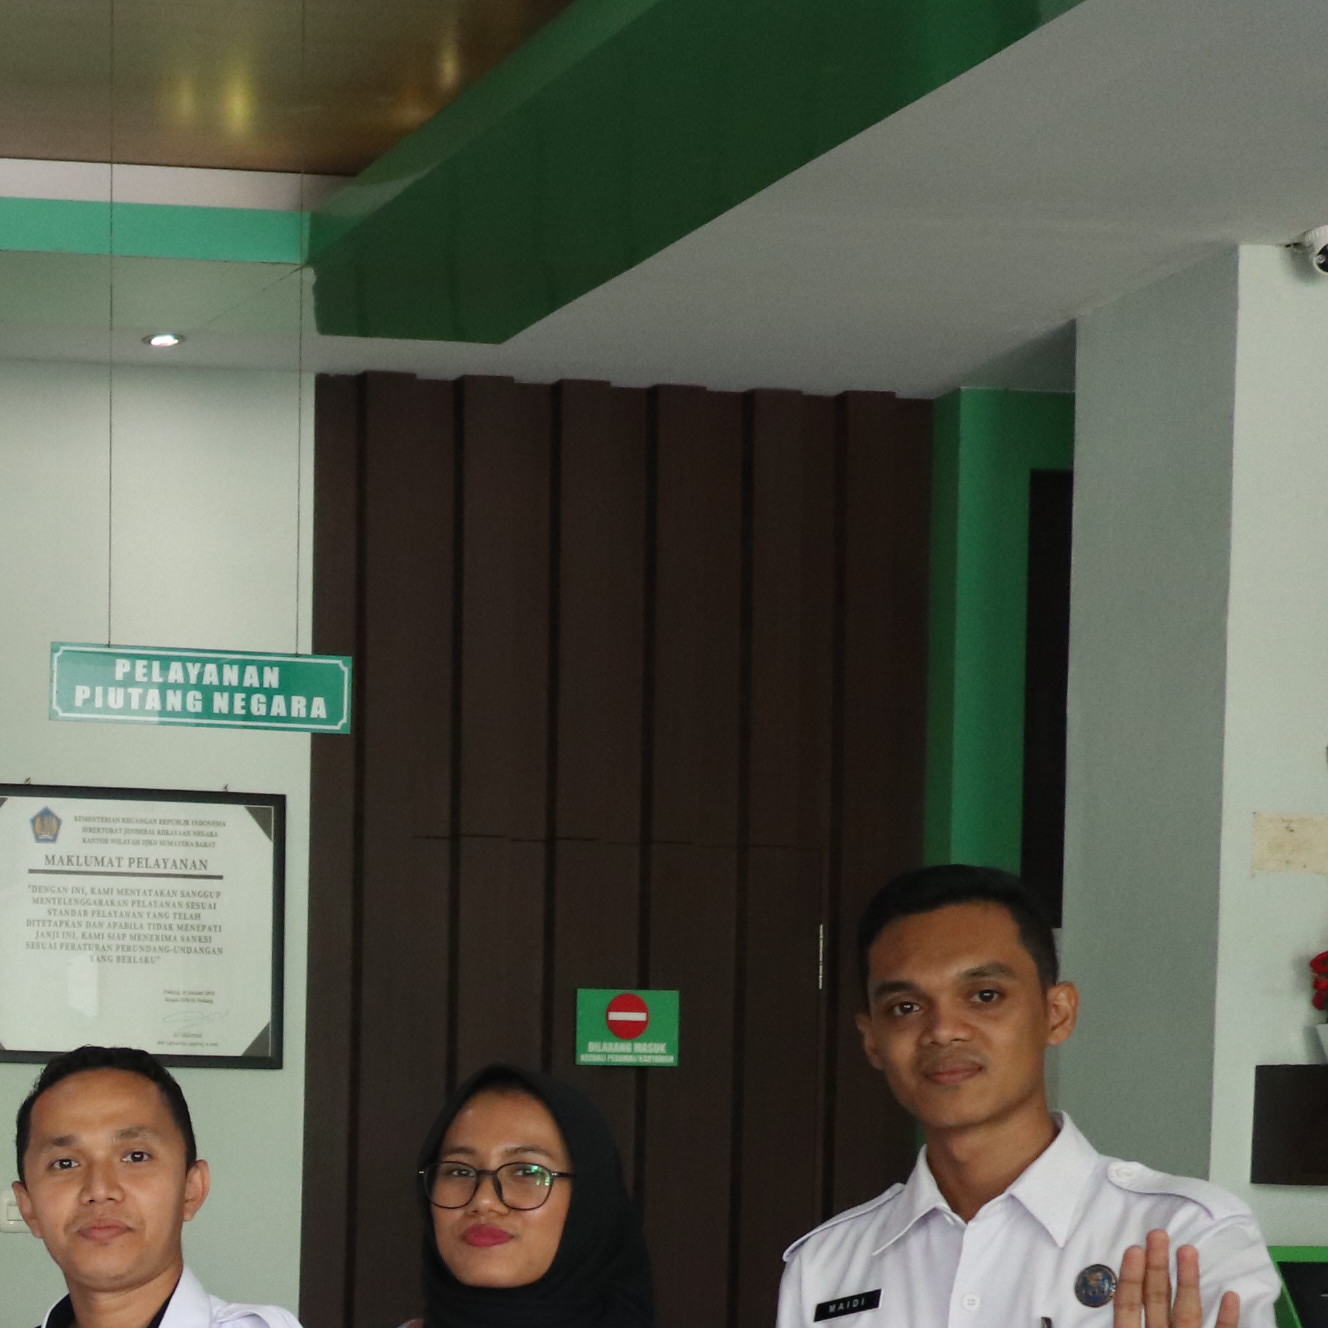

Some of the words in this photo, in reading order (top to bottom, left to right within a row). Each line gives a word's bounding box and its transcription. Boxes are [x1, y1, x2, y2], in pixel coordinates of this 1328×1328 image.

[114, 658, 280, 690] PELAYANAN
[74, 684, 203, 714] PIUTANG
[212, 691, 328, 720] NEGARA
[44, 854, 124, 869] MAKLUMAT
[127, 856, 208, 871] PELAYANAN
[90, 887, 114, 896] KAMI
[116, 887, 178, 898] MENYATAKAN
[179, 889, 222, 899] SANGGUP
[131, 899, 183, 909] PELAYANAN
[185, 901, 217, 910] SESUAI
[46, 908, 88, 918] STANDAR
[91, 909, 143, 919] PELAYANAN
[145, 911, 170, 920] YANG
[172, 912, 201, 921] TELAH
[25, 918, 82, 928] DITETAPKAN
[85, 920, 104, 929] DAN
[106, 921, 143, 931] APABILA
[146, 922, 173, 931] TIDAK
[176, 923, 222, 933] MENEPATI
[35, 930, 59, 941] JANJI
[81, 932, 104, 941] KAMI
[106, 932, 127, 941] SIAP
[129, 933, 177, 942] MENERIMA
[179, 934, 213, 944] SANKSI
[25, 941, 56, 950] SESUAI
[59, 942, 113, 952] PERATURAN
[115, 944, 224, 955] PERUNDANG-UNDANGAN
[89, 954, 114, 964] YANG
[828, 1297, 865, 1313] MAIDI
